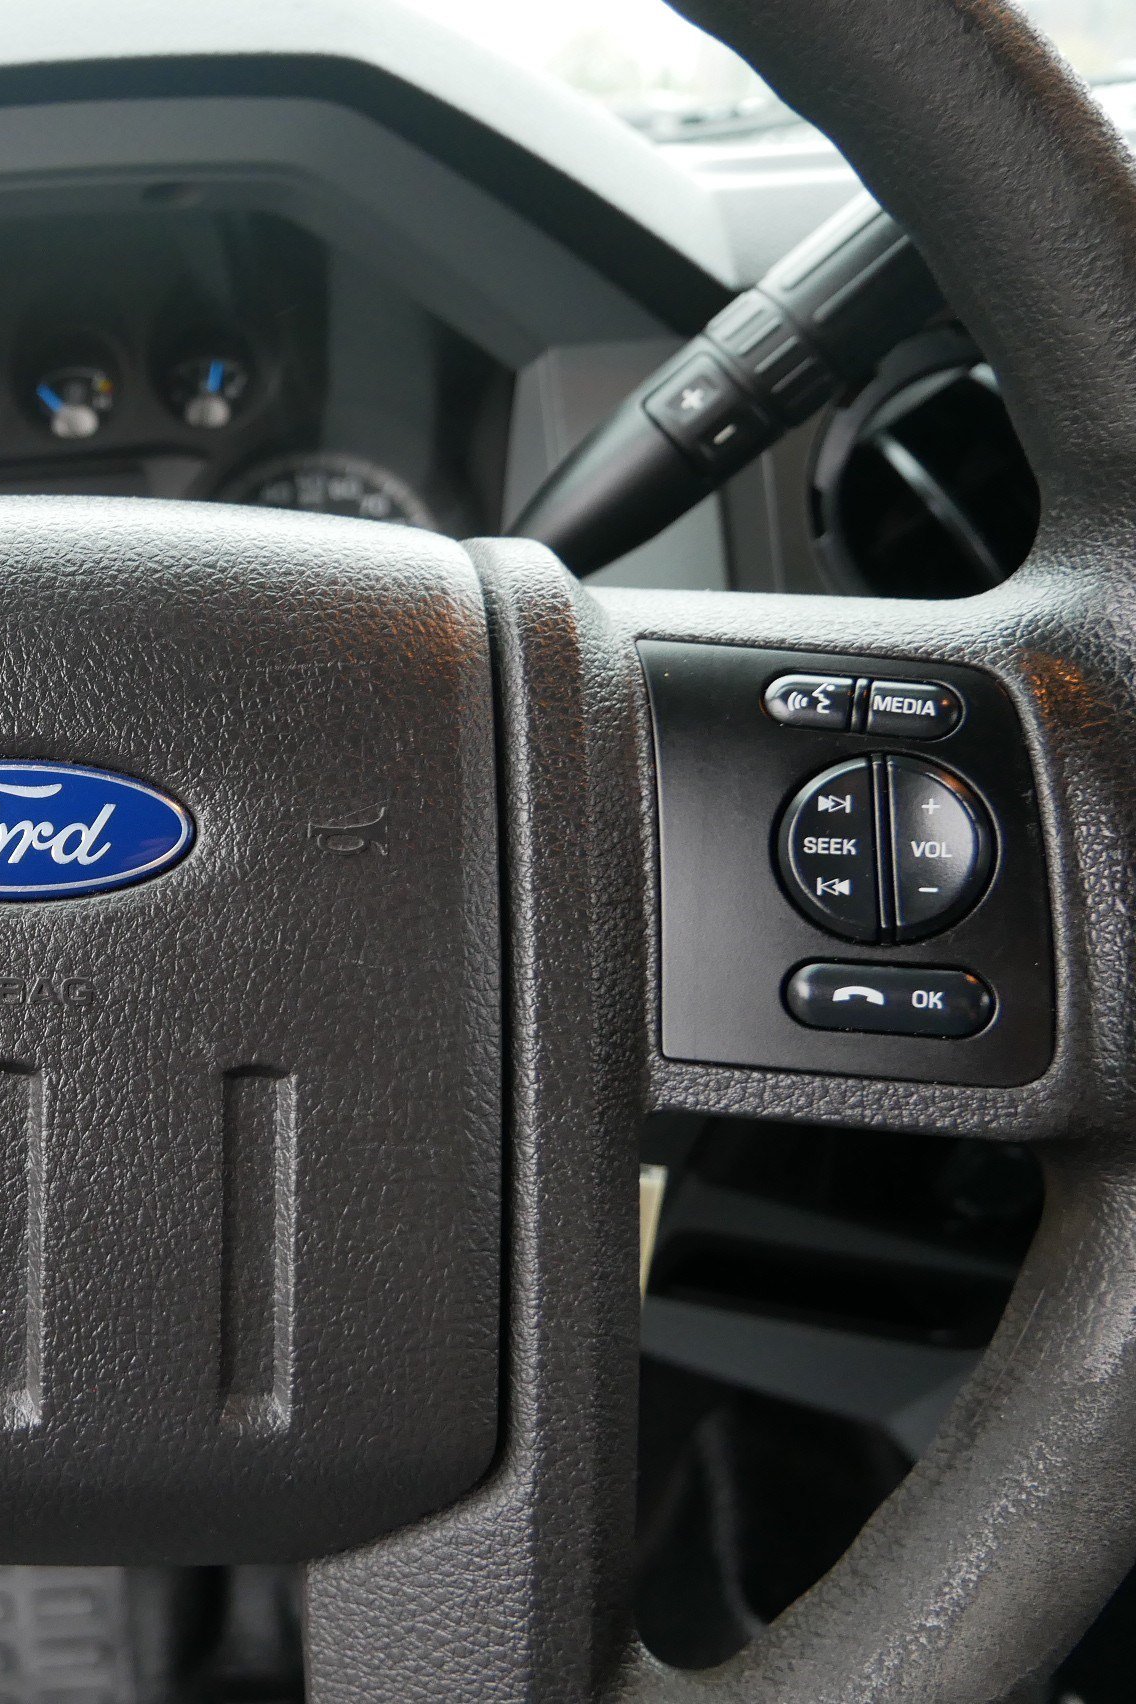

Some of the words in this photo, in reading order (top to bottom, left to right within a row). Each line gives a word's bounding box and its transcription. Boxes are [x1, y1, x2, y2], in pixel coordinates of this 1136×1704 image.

[872, 695, 936, 717] MEDIA
[803, 837, 857, 856] SEEK
[910, 841, 953, 859] VOL
[911, 990, 944, 1010] OK
